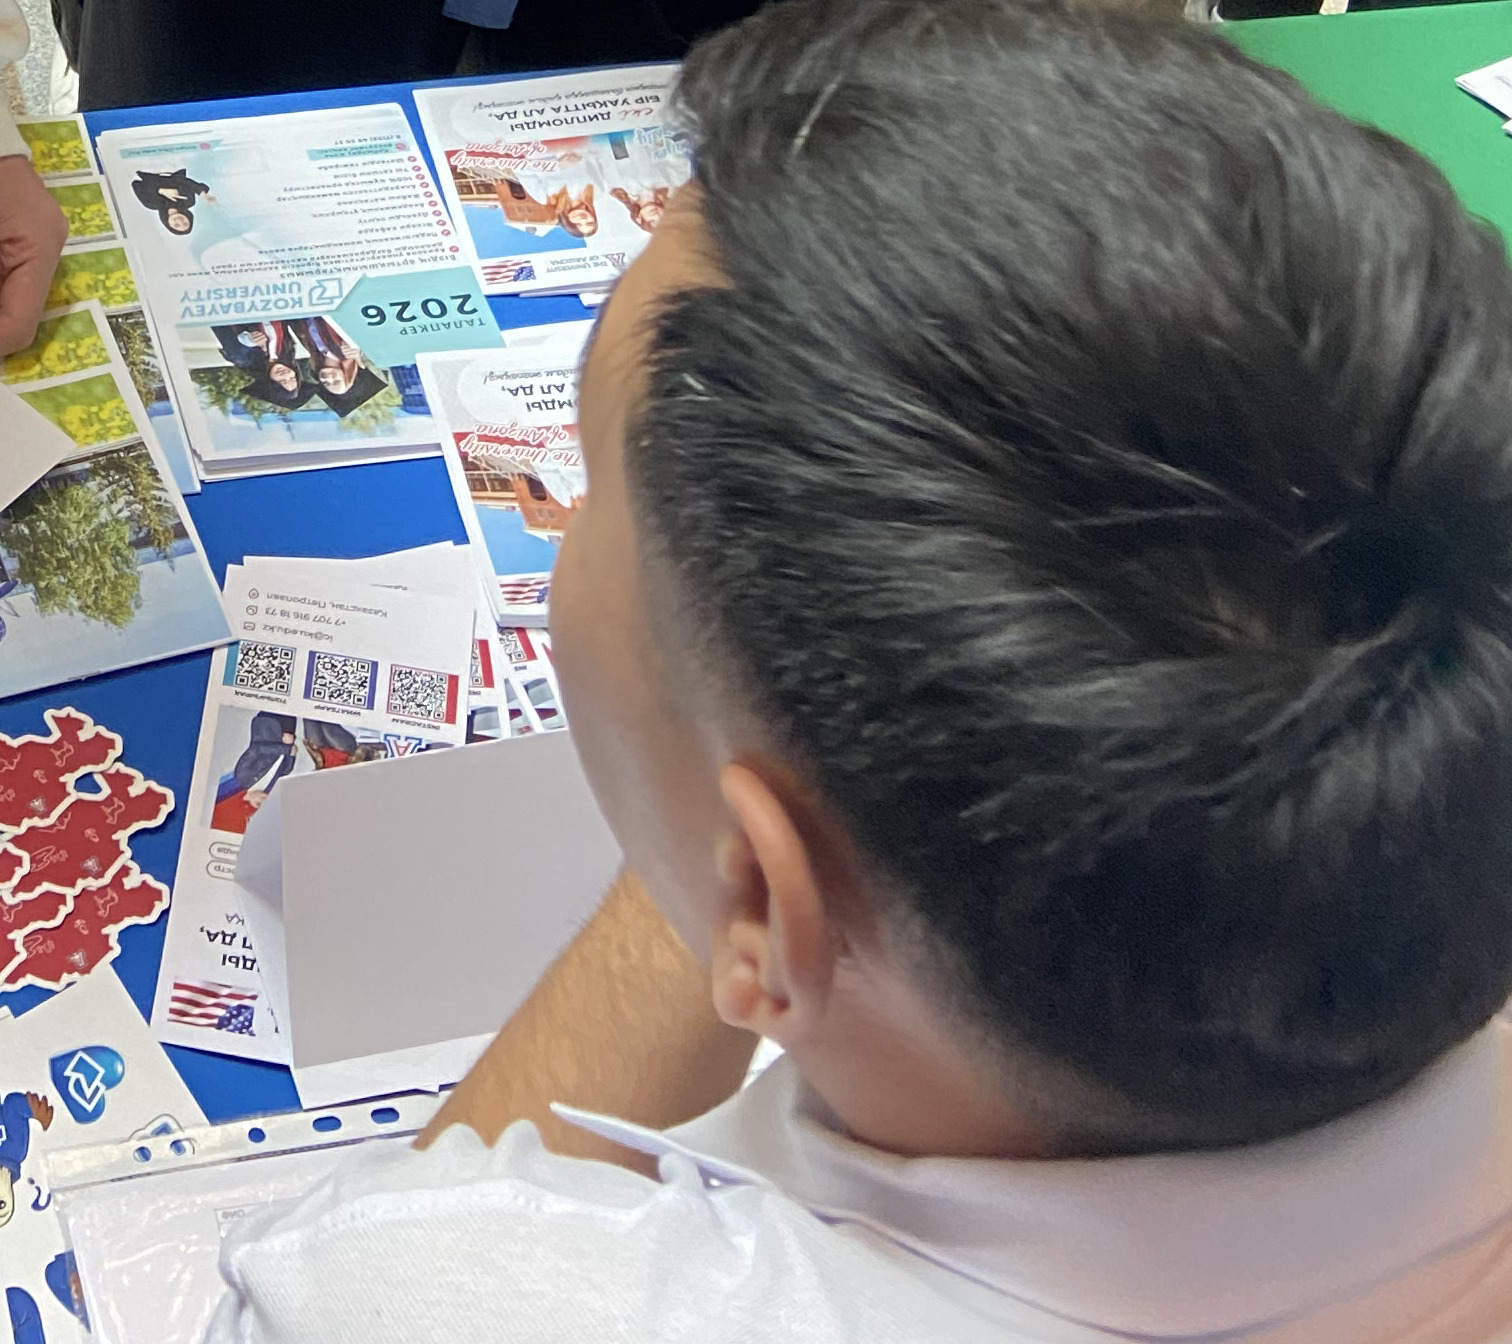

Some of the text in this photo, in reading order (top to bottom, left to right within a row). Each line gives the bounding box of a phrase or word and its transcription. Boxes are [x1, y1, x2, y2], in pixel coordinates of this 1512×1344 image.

[487, 94, 660, 121] БІР УАҚЫТТА АЛ ДА,
[509, 111, 612, 132] ДИПЛОМДЫ
[179, 280, 301, 303] UNIVERSITY
[179, 296, 303, 319] KOZYBAYEV
[360, 294, 479, 327] 2026
[398, 316, 486, 336] ТАЛАПКЕР
[500, 383, 566, 397] АЛ ДА,
[473, 421, 545, 443] Arizona
[458, 434, 581, 467] The University
[264, 607, 278, 617] 73
[279, 609, 291, 619] 18
[291, 610, 311, 622] 916
[312, 615, 333, 625] 707
[262, 623, 334, 643] ic@ku.edu.kz
